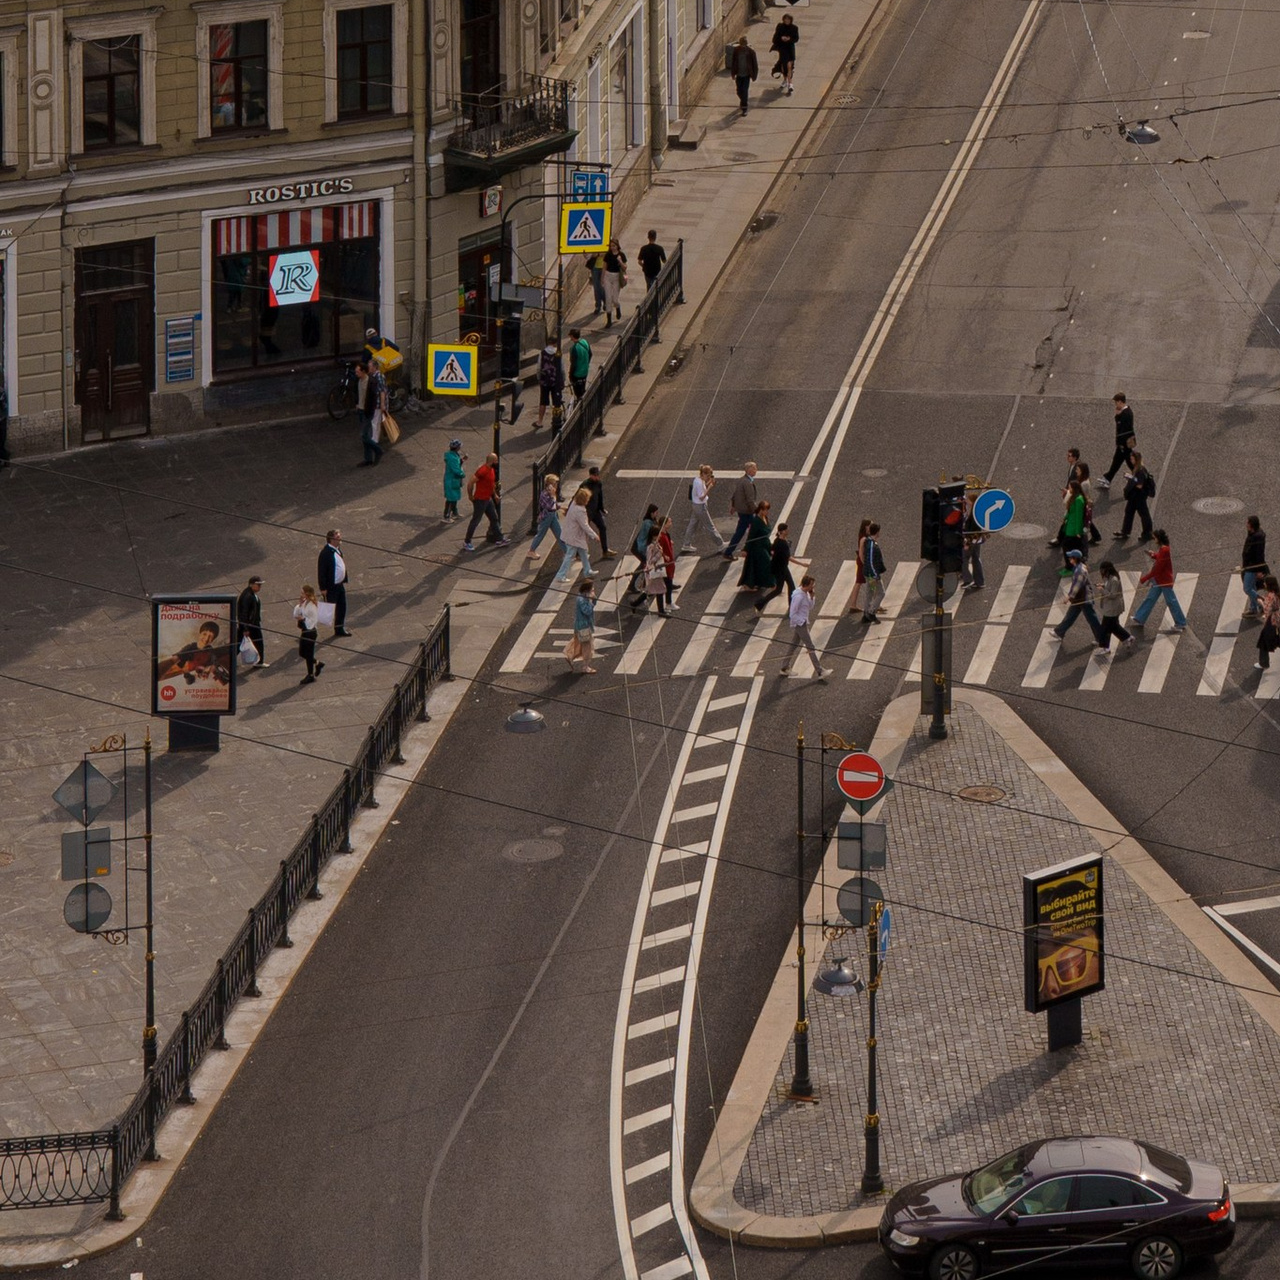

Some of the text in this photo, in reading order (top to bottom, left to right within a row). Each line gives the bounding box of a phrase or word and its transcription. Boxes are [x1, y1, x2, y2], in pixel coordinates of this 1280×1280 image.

[249, 178, 354, 204] ROSTIC'S
[1040, 889, 1096, 914] выбирайте
[1050, 900, 1096, 921] свой вид
